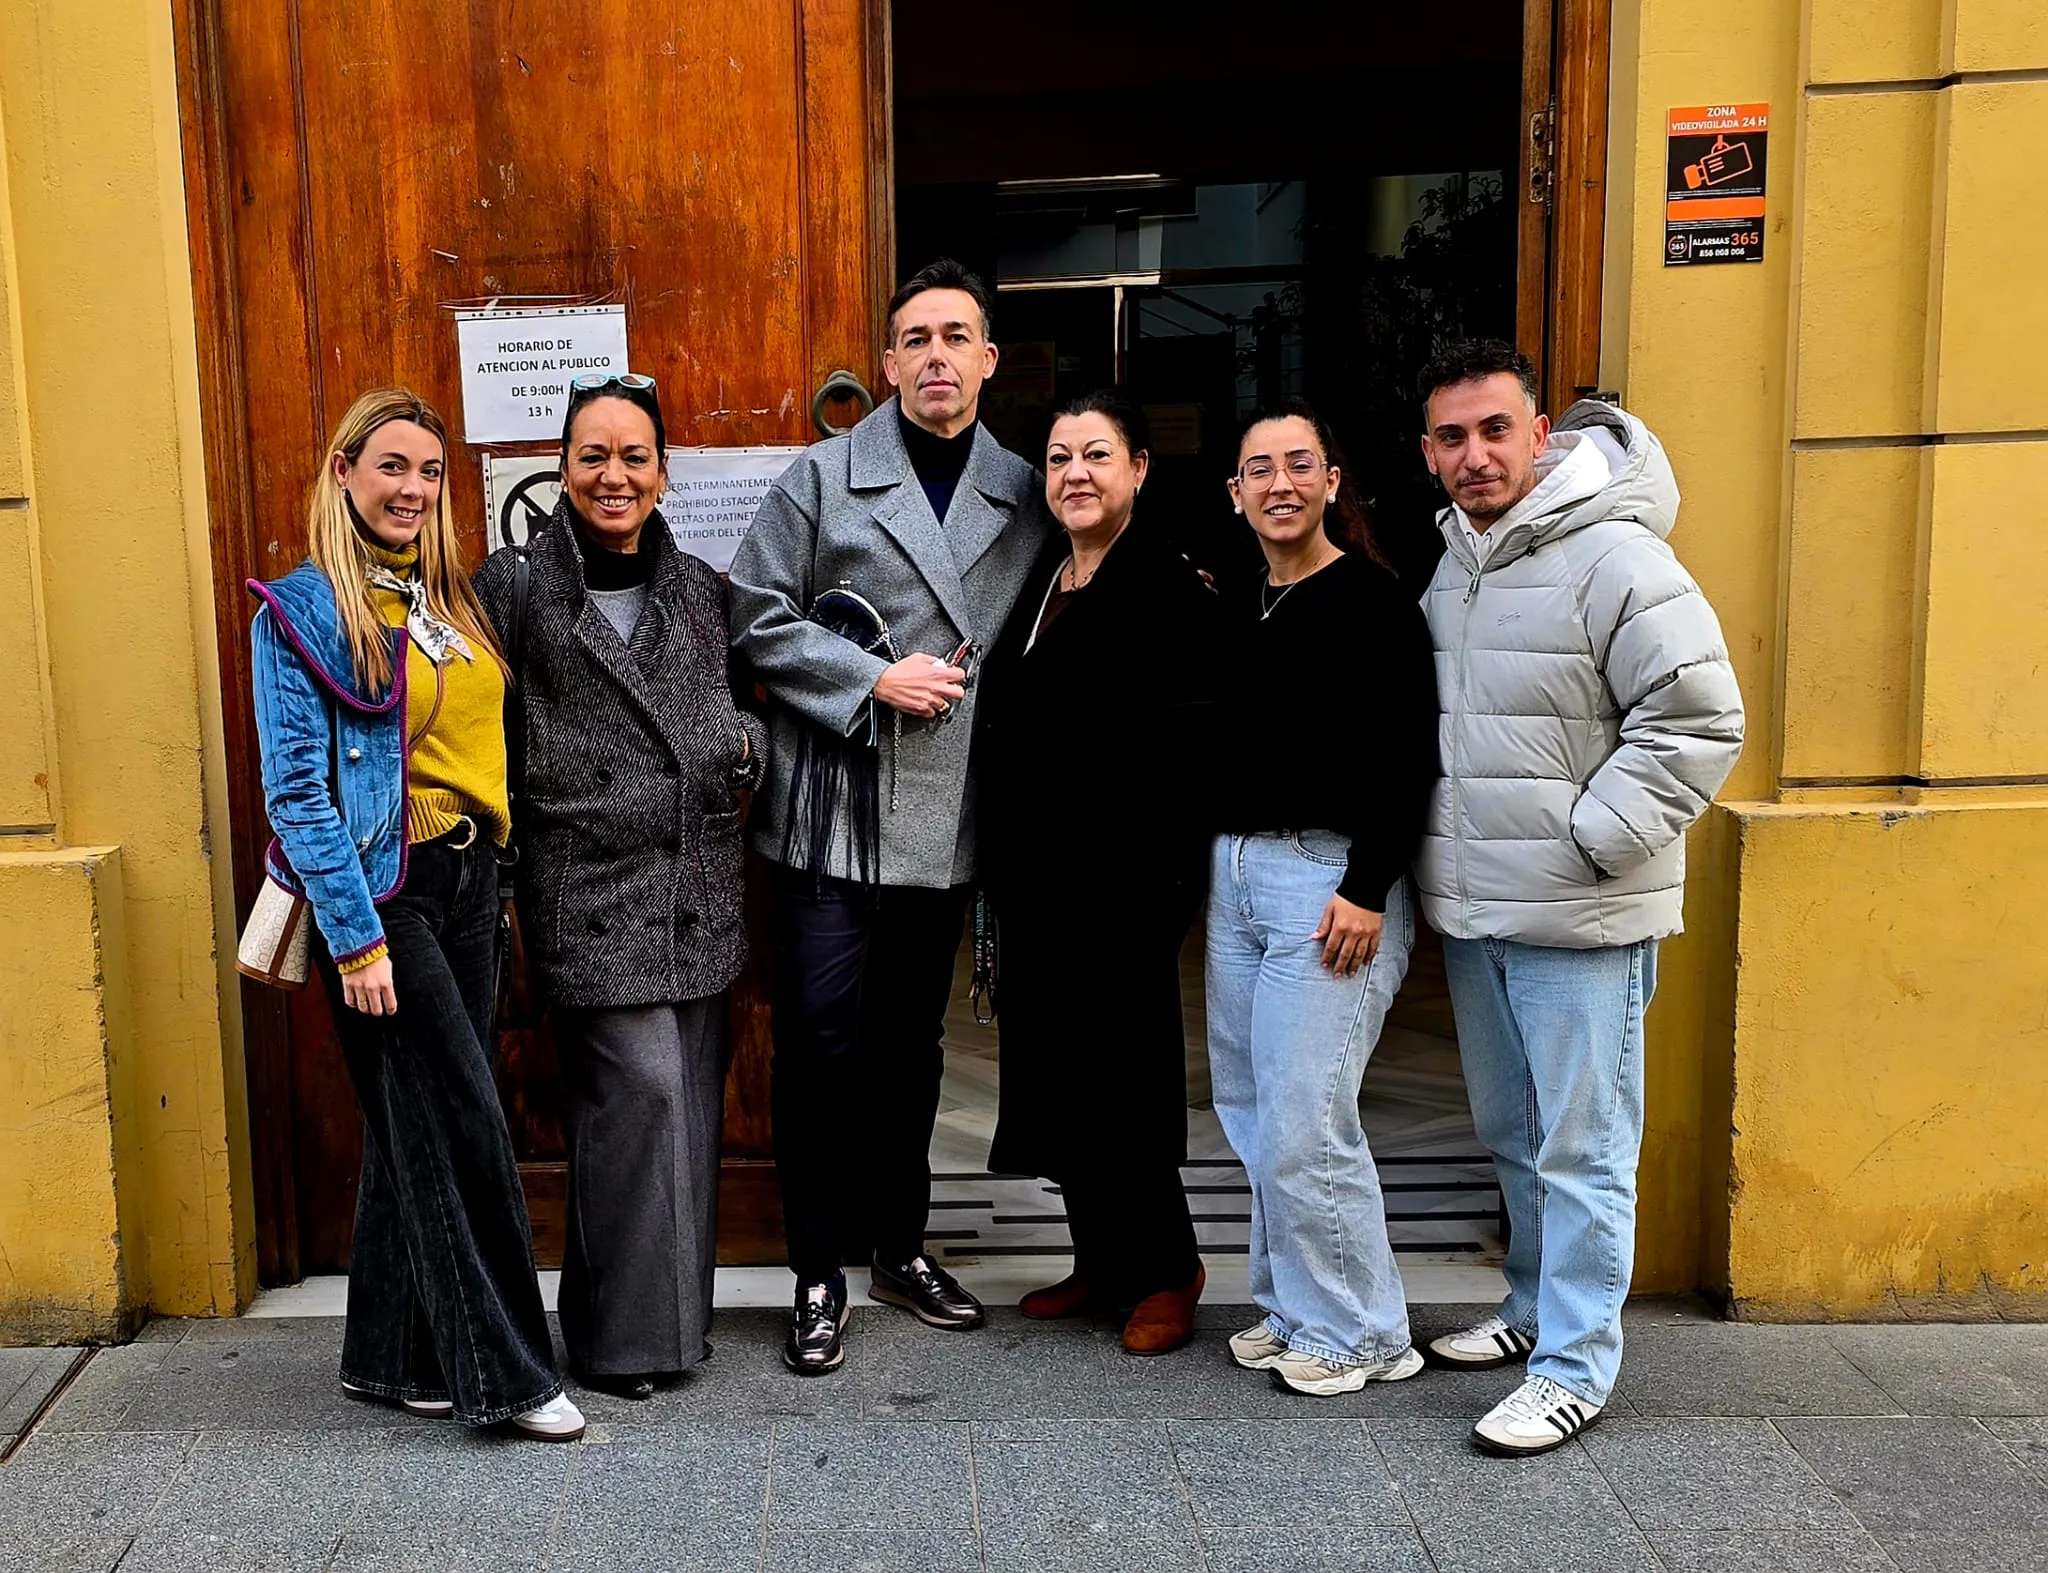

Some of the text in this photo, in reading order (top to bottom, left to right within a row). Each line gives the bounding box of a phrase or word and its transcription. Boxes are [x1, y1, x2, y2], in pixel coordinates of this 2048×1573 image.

[1707, 106, 1736, 117] ZONA
[1671, 116, 1767, 131] VIDEOVIGILADA 24 H
[1693, 232, 1759, 246] ALARMAS 365
[498, 339, 573, 354] HORARIO DE
[477, 356, 611, 374] ATENCION AL PUBLICO
[512, 384, 565, 397] DE 9:00H
[528, 404, 553, 417] 13 h
[666, 498, 719, 510] PROHIBIDO
[706, 513, 715, 523] O
[718, 527, 735, 538] DEL
